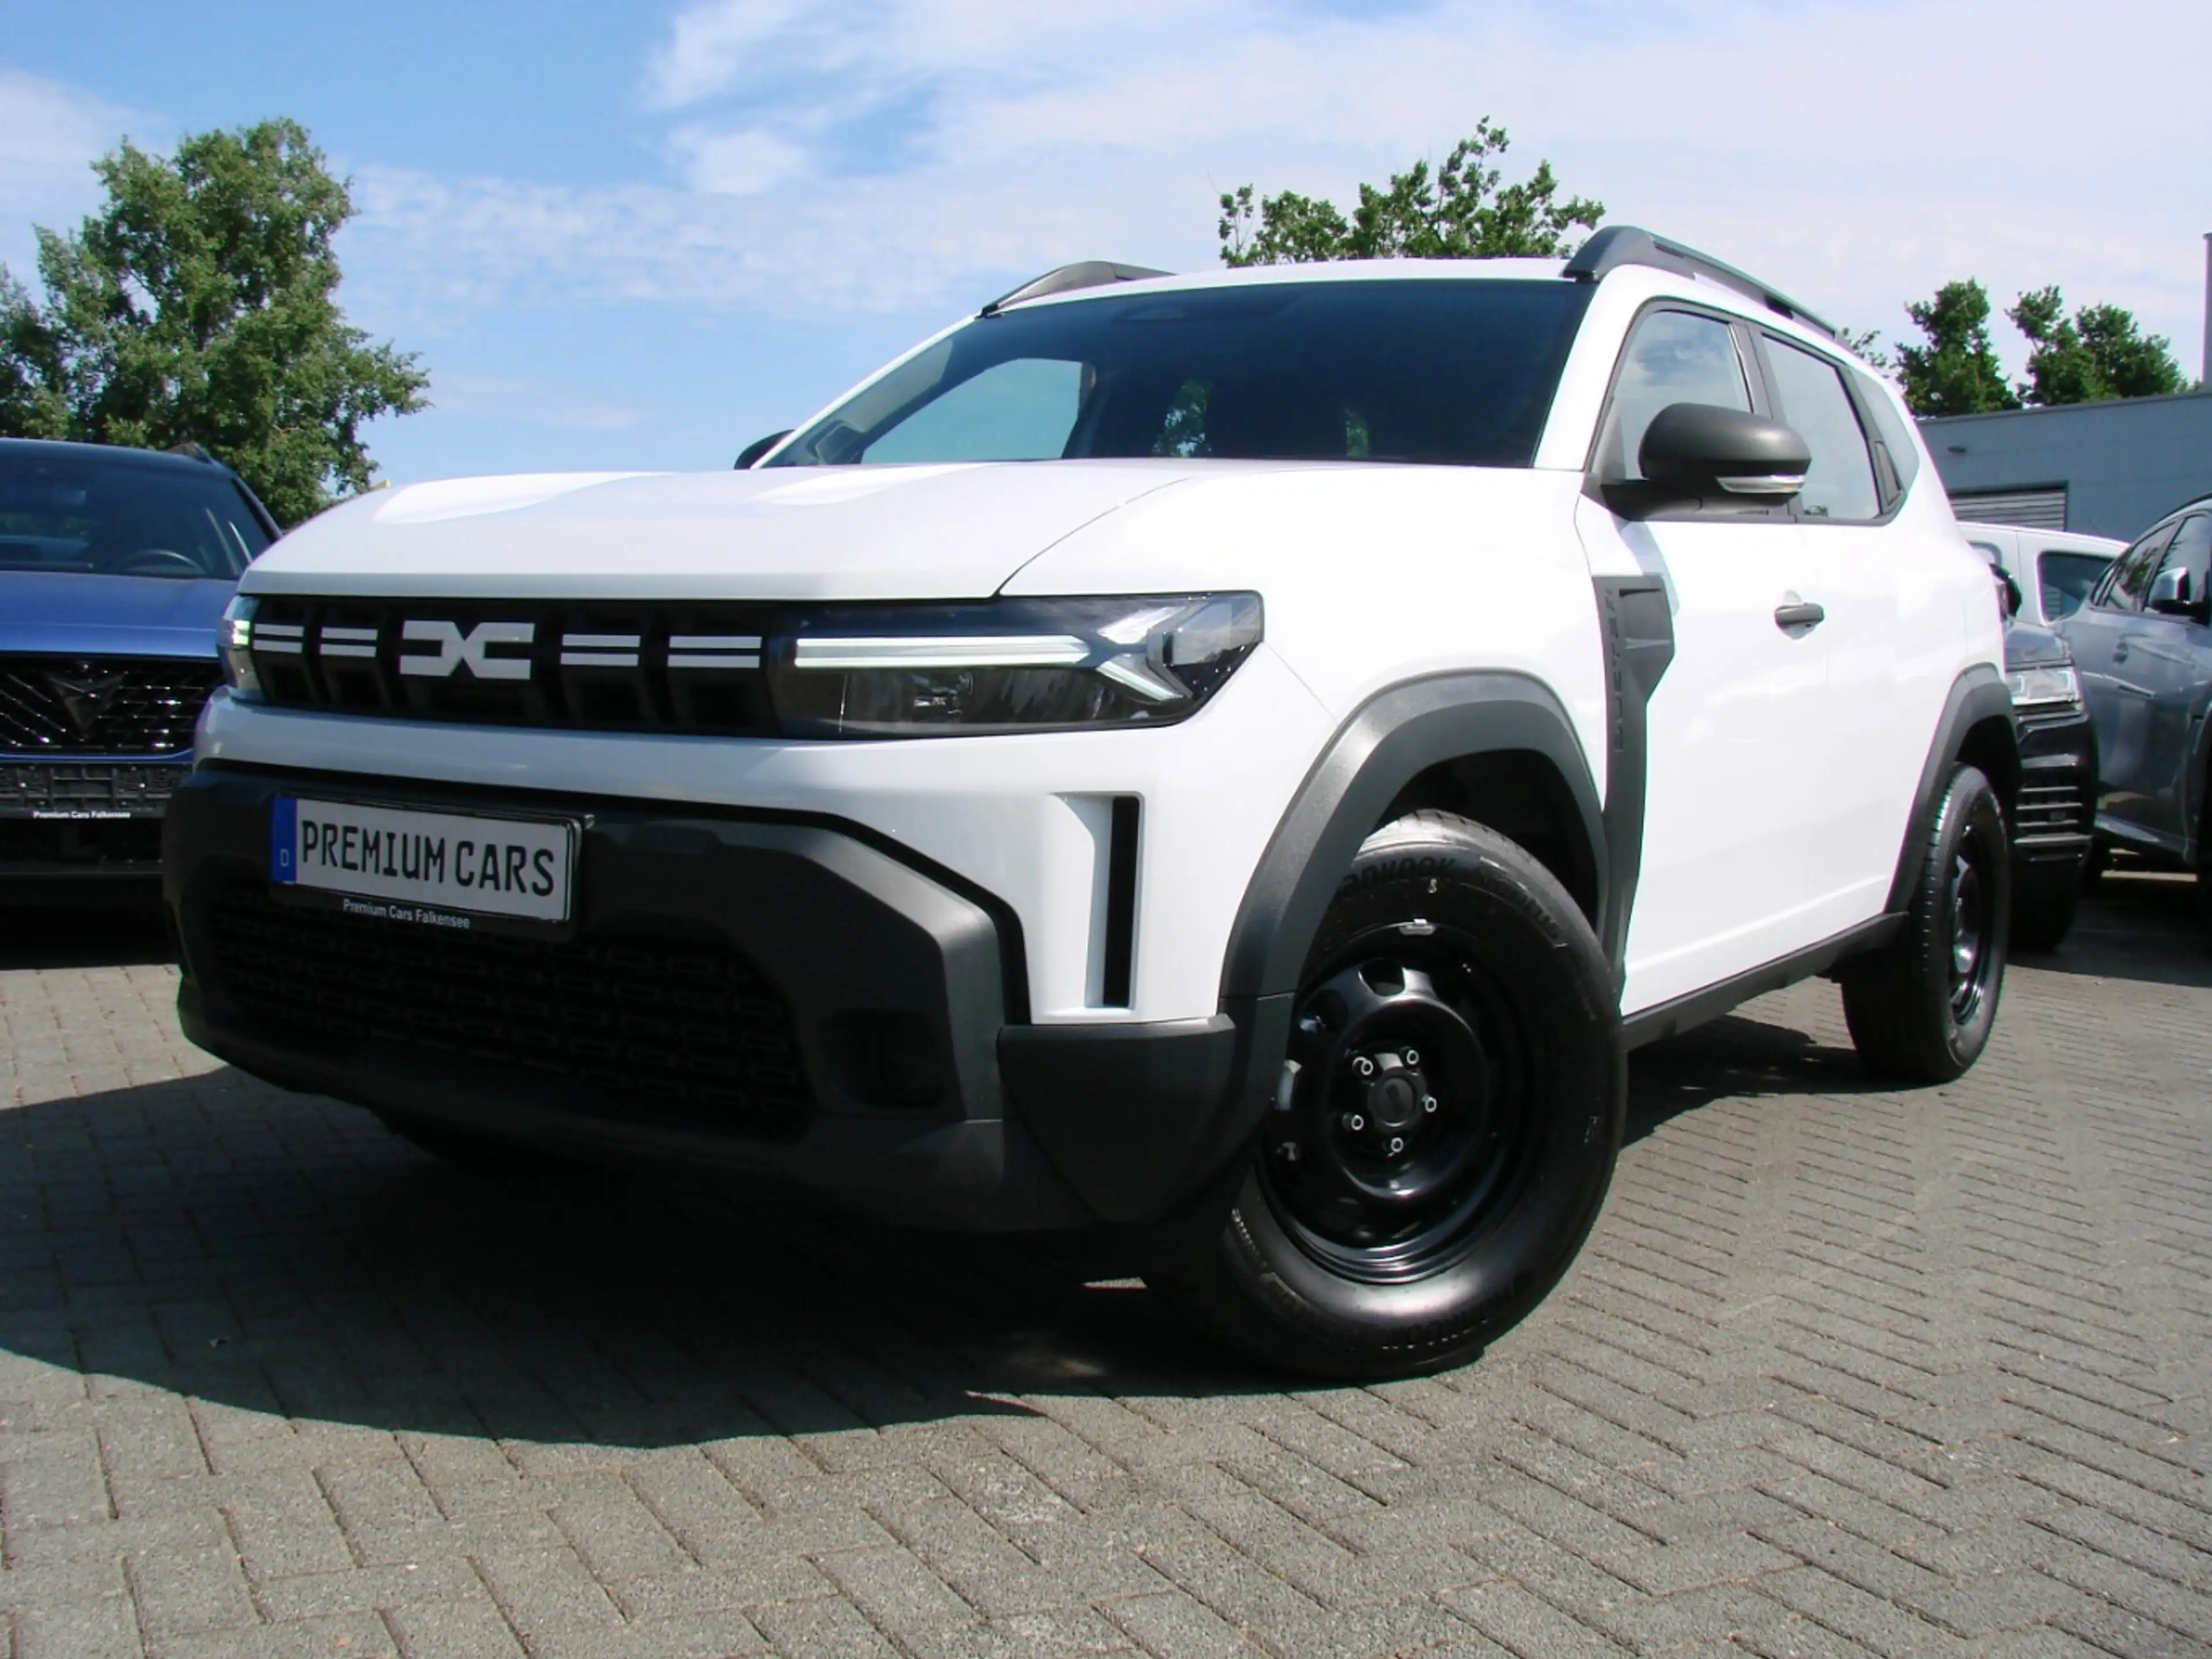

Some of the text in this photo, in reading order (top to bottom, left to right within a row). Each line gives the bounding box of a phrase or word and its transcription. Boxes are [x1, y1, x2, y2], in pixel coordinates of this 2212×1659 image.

[71, 810, 90, 819] Cars
[280, 849, 289, 867] D
[302, 820, 554, 897] PREMIUM CARS
[343, 898, 471, 929] Premium Cars Falkensee
